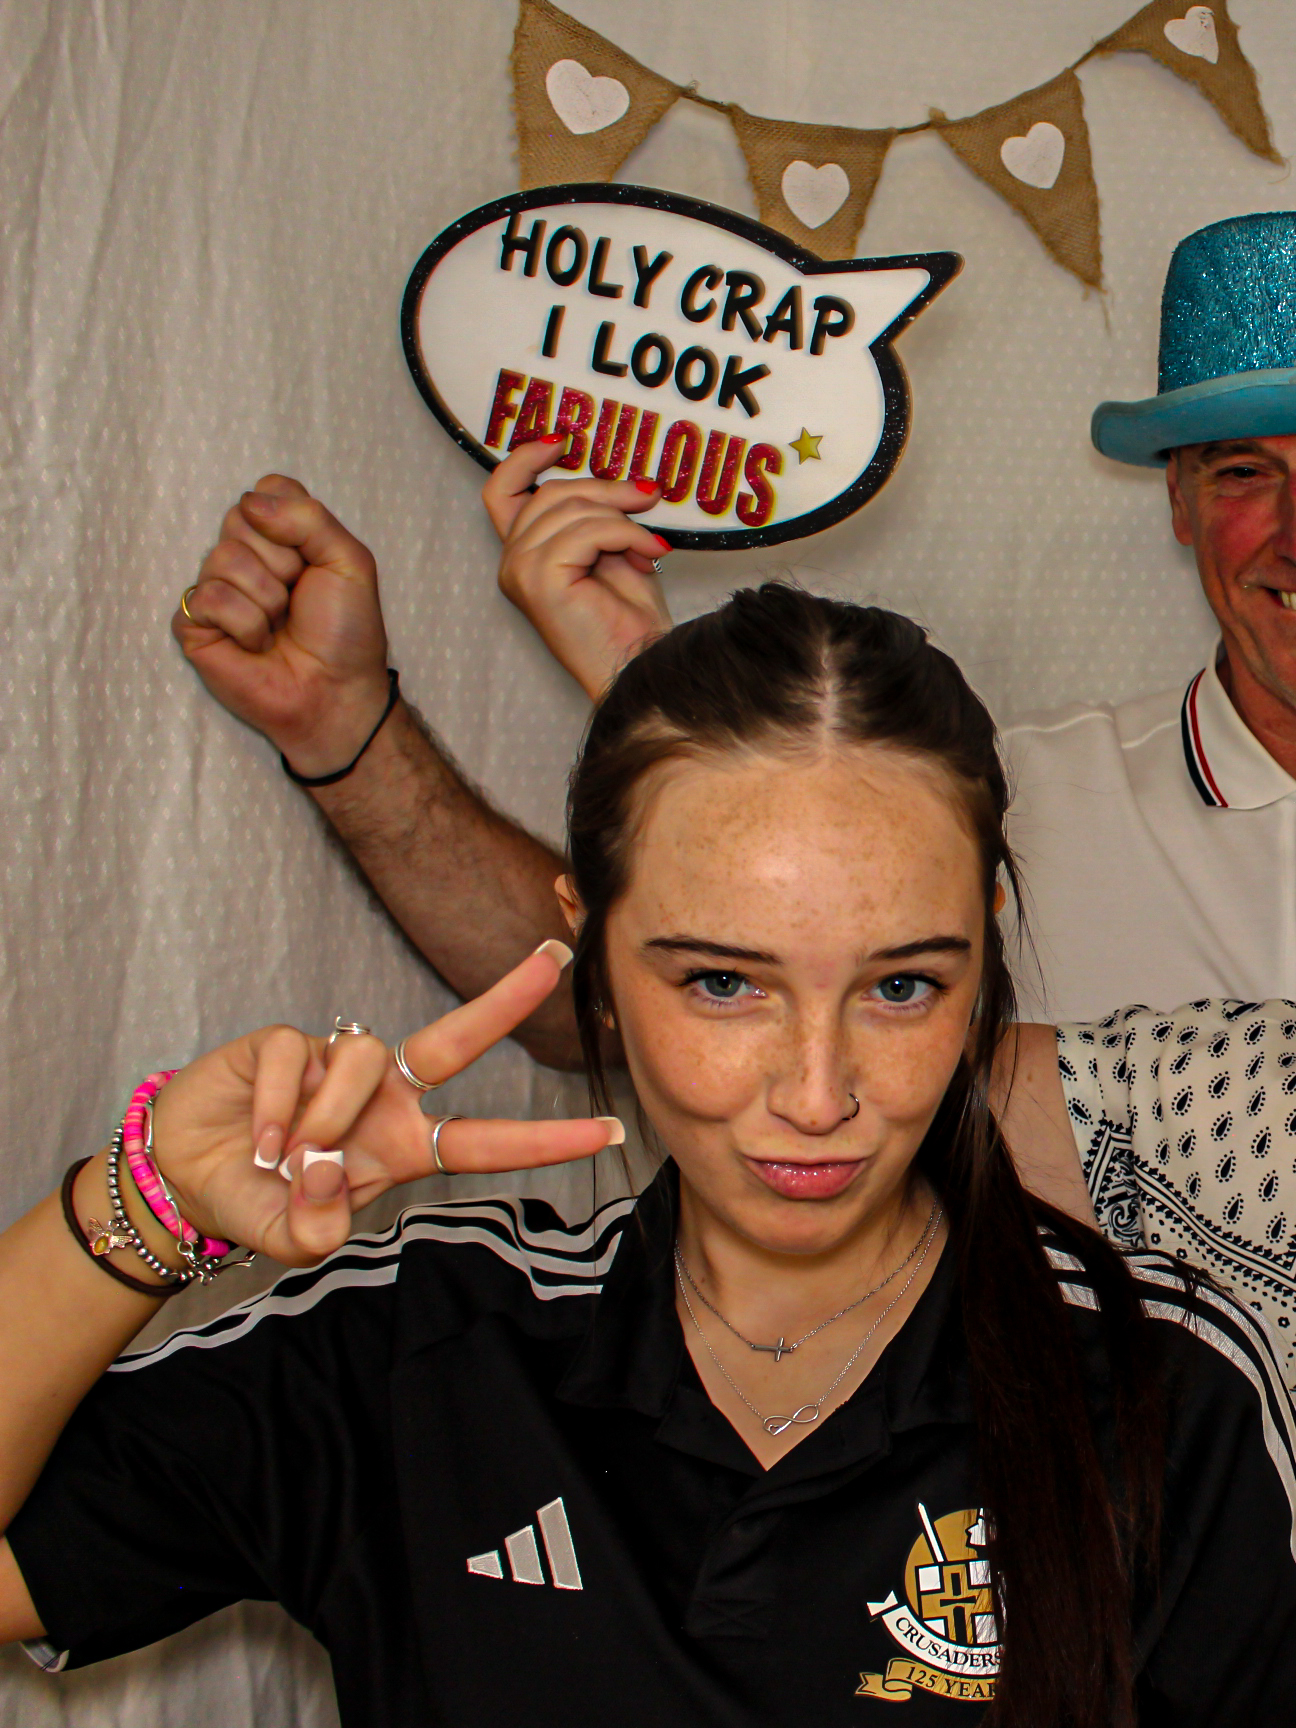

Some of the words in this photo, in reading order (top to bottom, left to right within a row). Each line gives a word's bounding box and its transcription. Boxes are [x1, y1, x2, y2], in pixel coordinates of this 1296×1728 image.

[500, 212, 674, 308] HOLY
[680, 264, 856, 356] CRAP
[541, 304, 566, 358] I
[591, 320, 771, 418] LOOK
[483, 367, 783, 528] FABULOUS
[906, 1666, 938, 1688] 125
